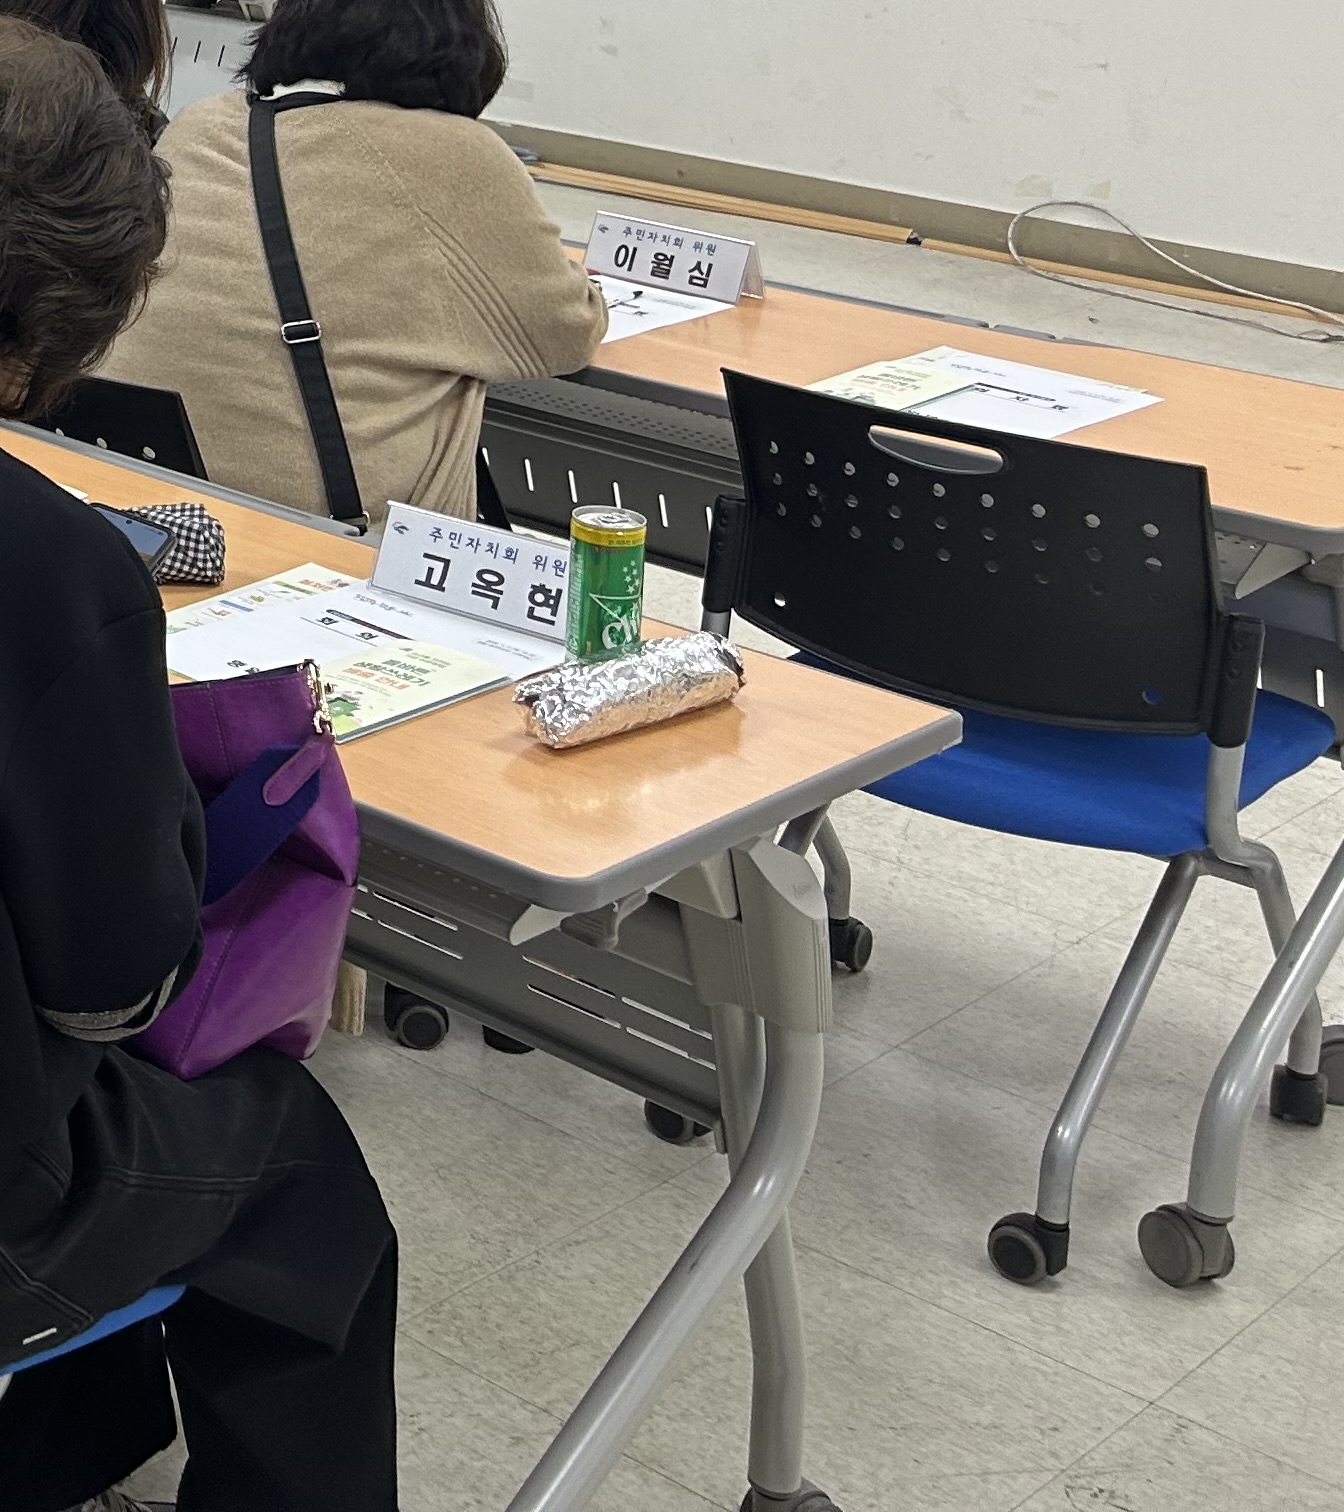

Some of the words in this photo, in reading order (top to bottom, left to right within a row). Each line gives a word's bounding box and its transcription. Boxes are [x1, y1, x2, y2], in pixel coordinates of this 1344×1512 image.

[623, 226, 684, 249] 주민자치회
[693, 241, 717, 256] 위원
[614, 244, 713, 288] 이월심
[429, 526, 520, 565] 주민자치회
[532, 554, 568, 578] 위원
[414, 552, 564, 627] 고옥현
